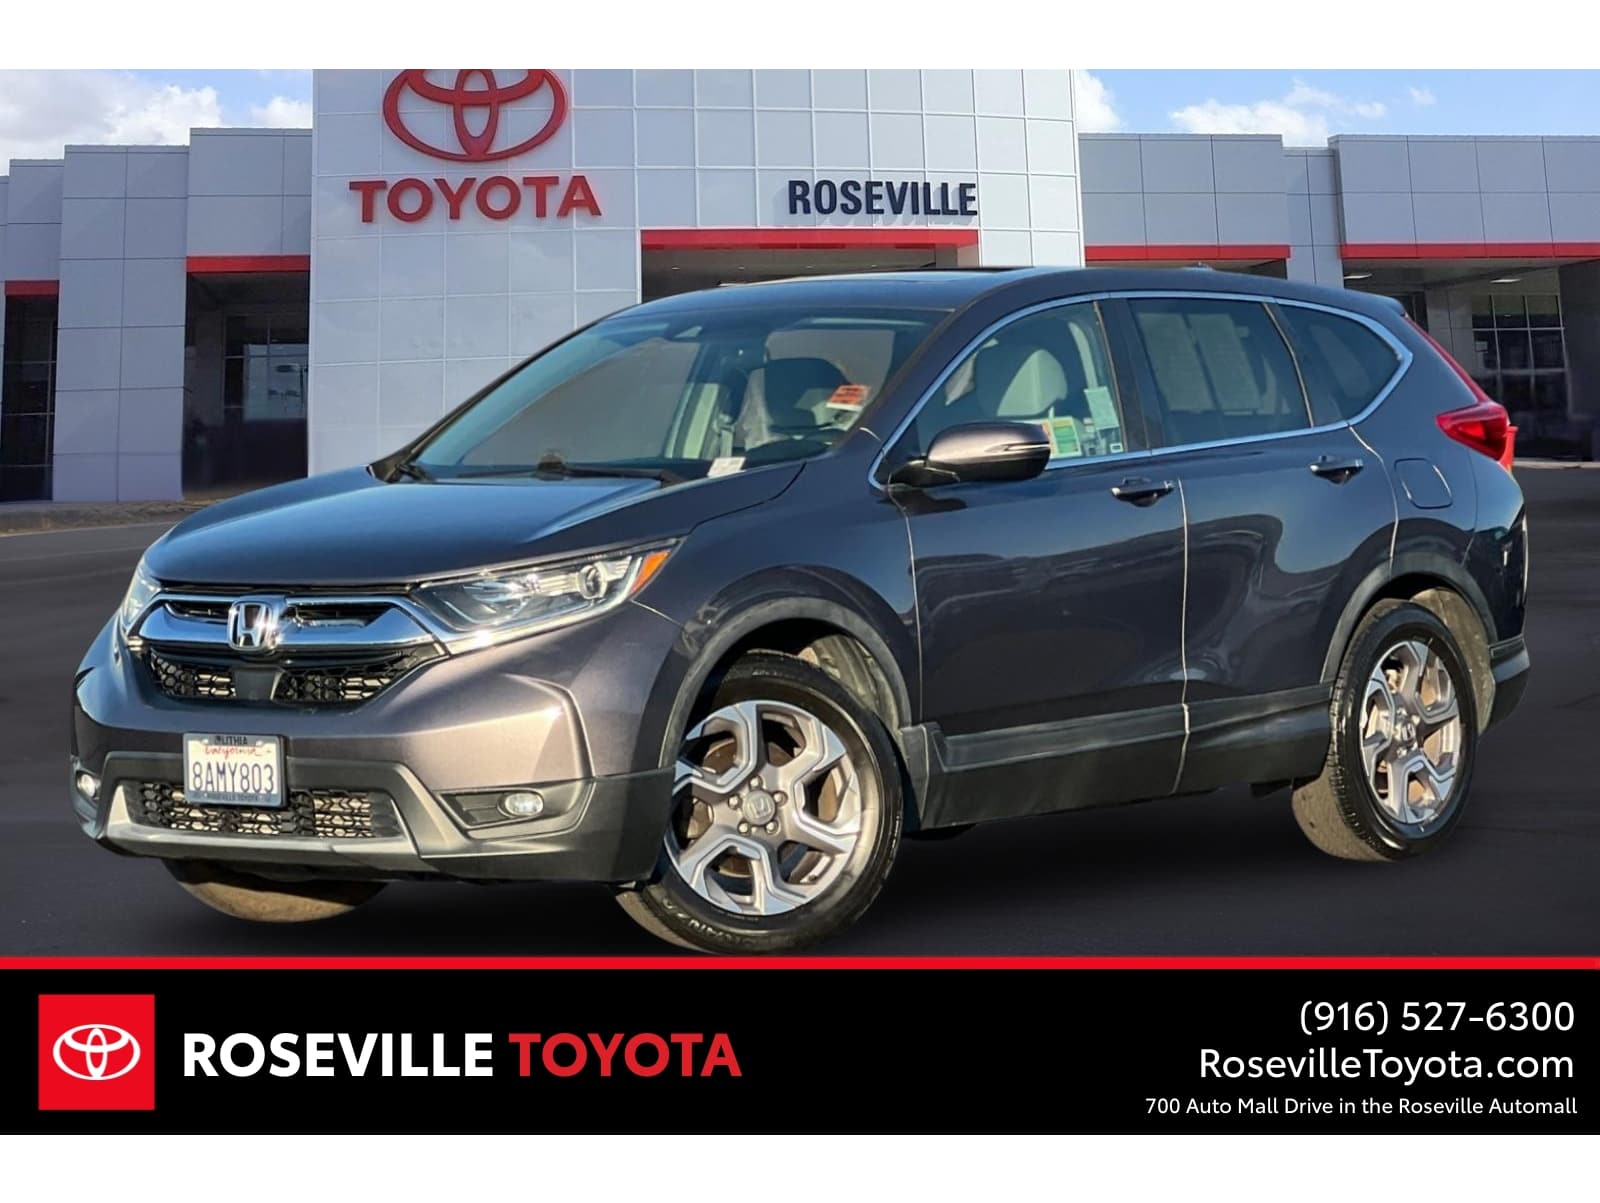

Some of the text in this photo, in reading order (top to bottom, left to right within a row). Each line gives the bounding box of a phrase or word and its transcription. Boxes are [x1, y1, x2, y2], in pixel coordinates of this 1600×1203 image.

[349, 174, 602, 224] TOYOTA
[788, 179, 978, 216] ROSEVILLE
[192, 761, 274, 794] 8AMY803
